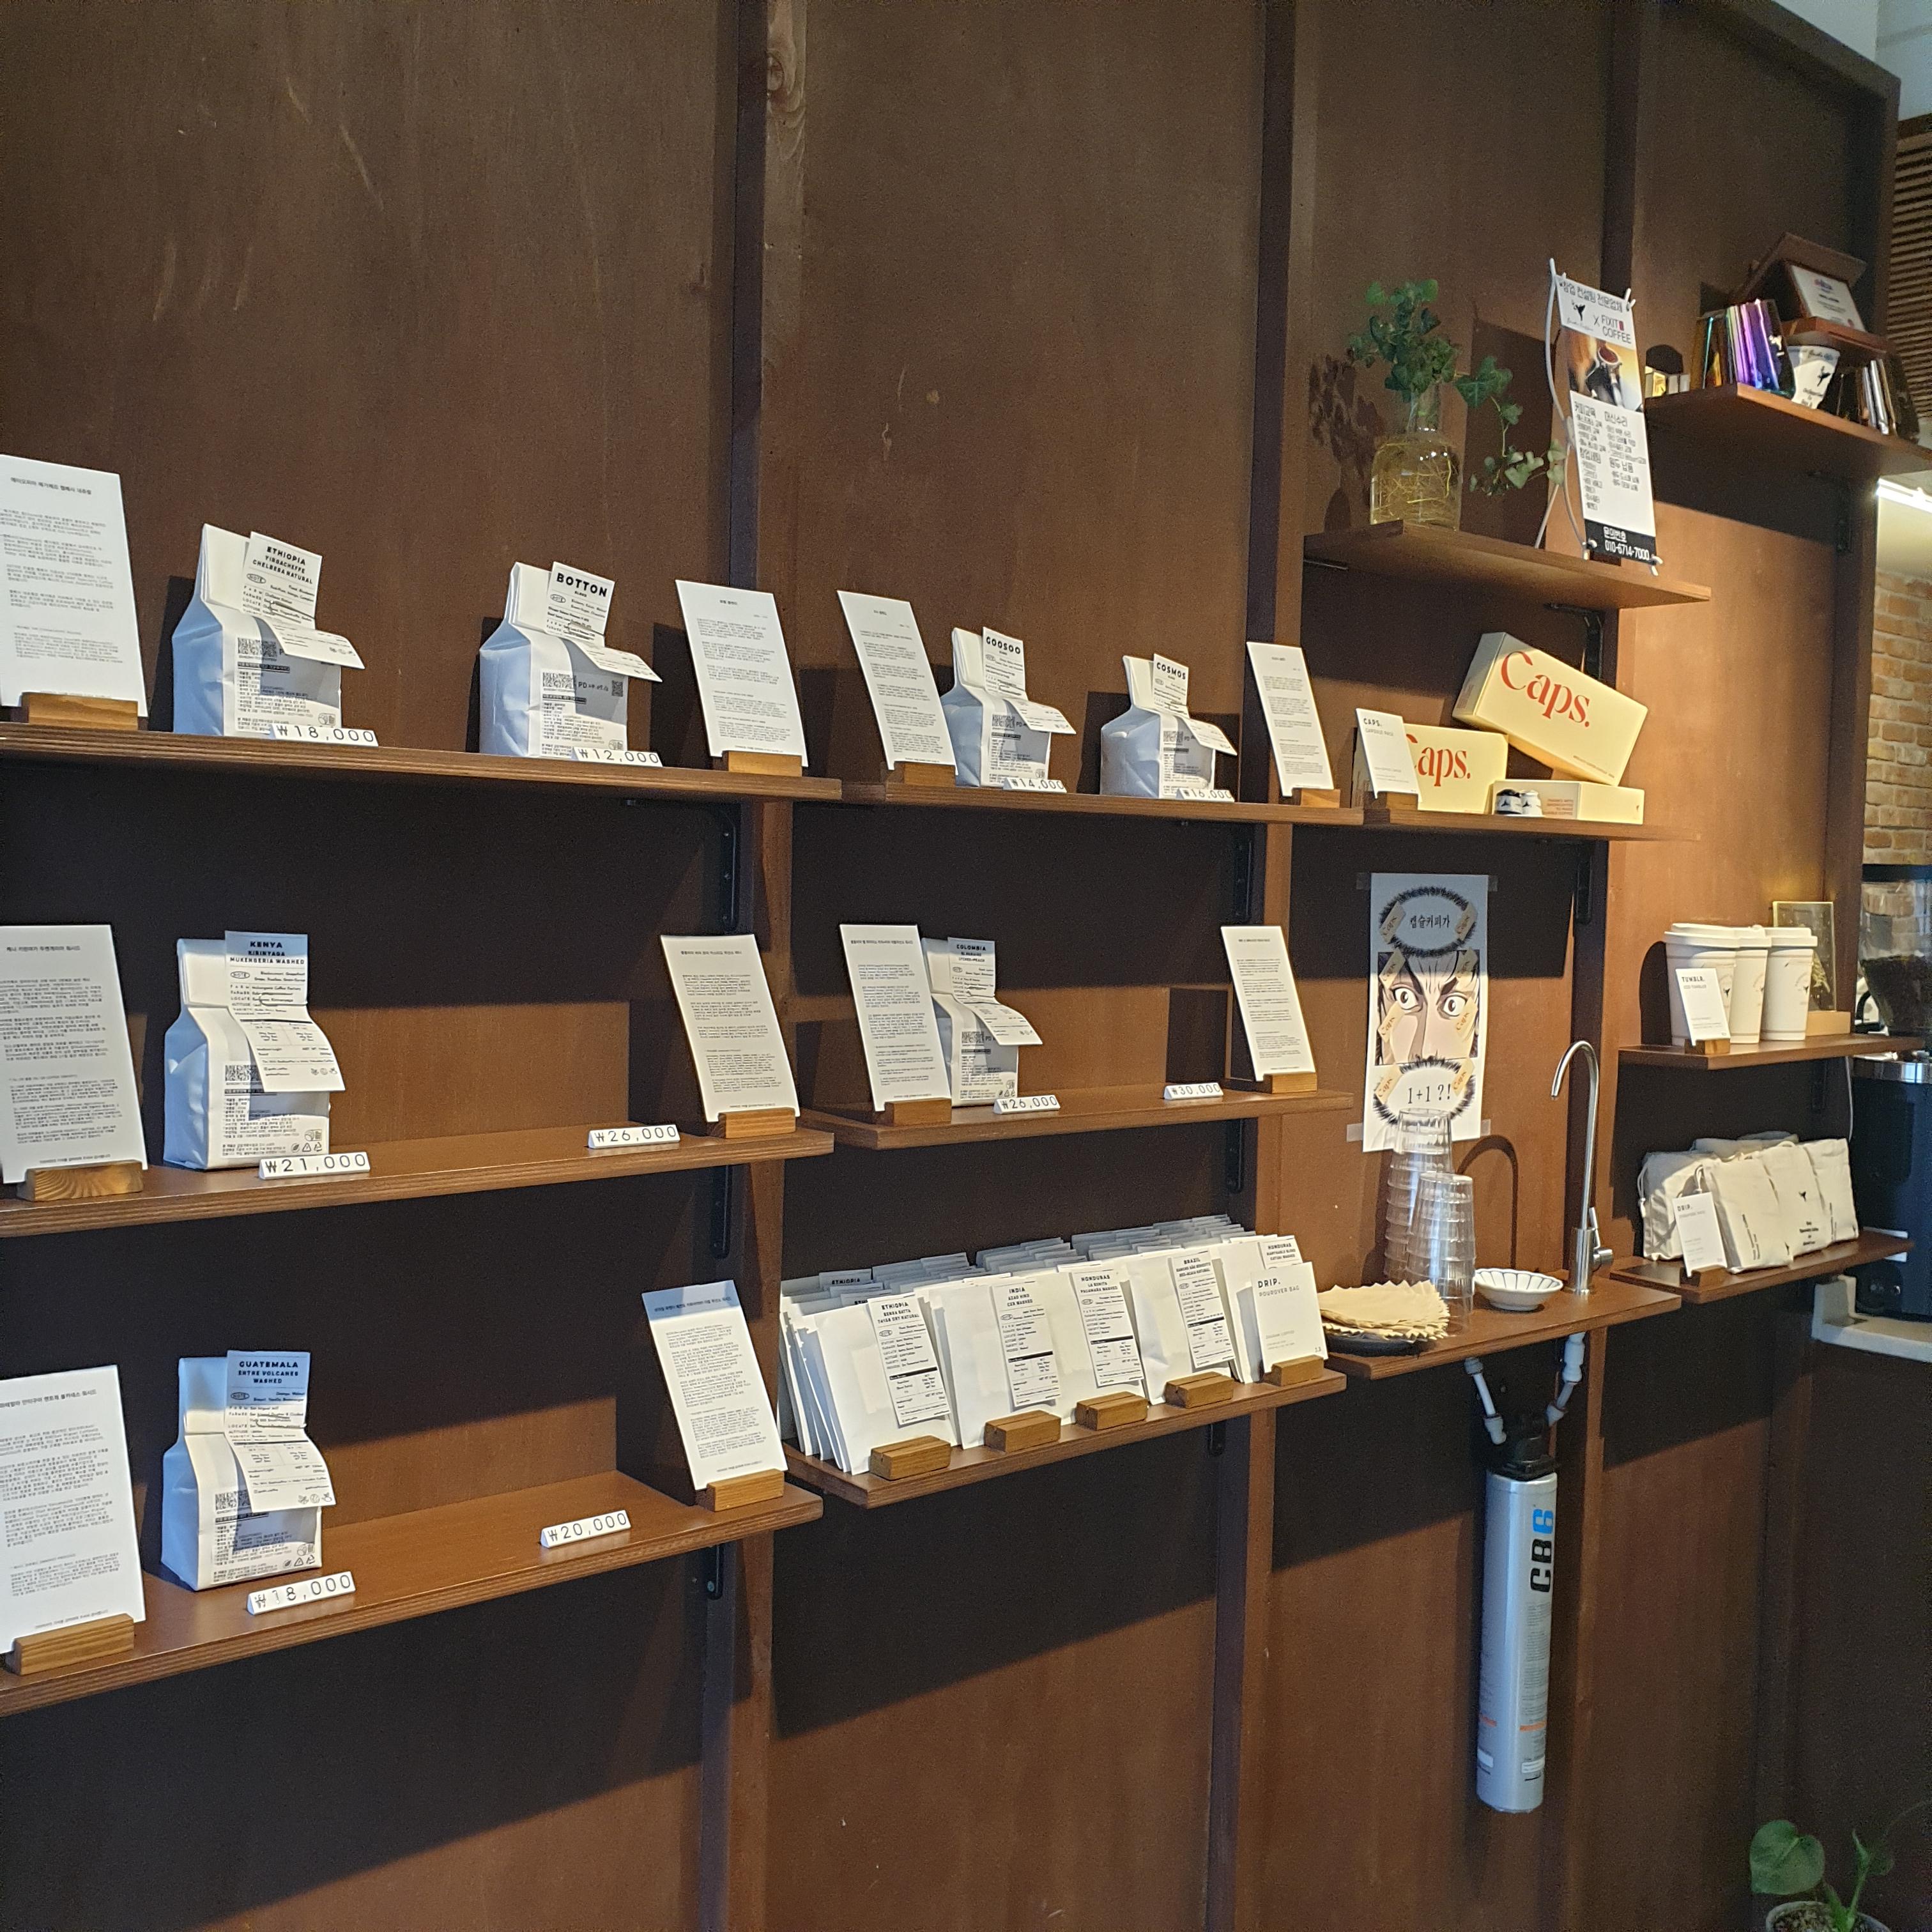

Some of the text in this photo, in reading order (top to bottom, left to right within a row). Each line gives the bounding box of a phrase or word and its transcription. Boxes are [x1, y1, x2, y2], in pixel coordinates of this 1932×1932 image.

[1602, 326, 1631, 344] COFFEE
[267, 546, 306, 566] ETHIOPIA
[286, 571, 313, 585] NATURAL
[556, 572, 608, 597] BOTTON
[986, 636, 1021, 655] GOOSOO
[1156, 662, 1186, 680] COSMOS
[1501, 650, 1590, 728] Caps.
[1410, 914, 1450, 929] 캡슐커피가
[250, 940, 283, 949] KENYA
[594, 1125, 677, 1143] ₩26,000
[264, 1154, 366, 1174] ₩21,000
[1081, 1274, 1110, 1282] HONDURAS
[1257, 1278, 1281, 1289] DRIP.
[882, 1301, 909, 1310] ETHIOPIA
[547, 1511, 627, 1542] ₩20,000
